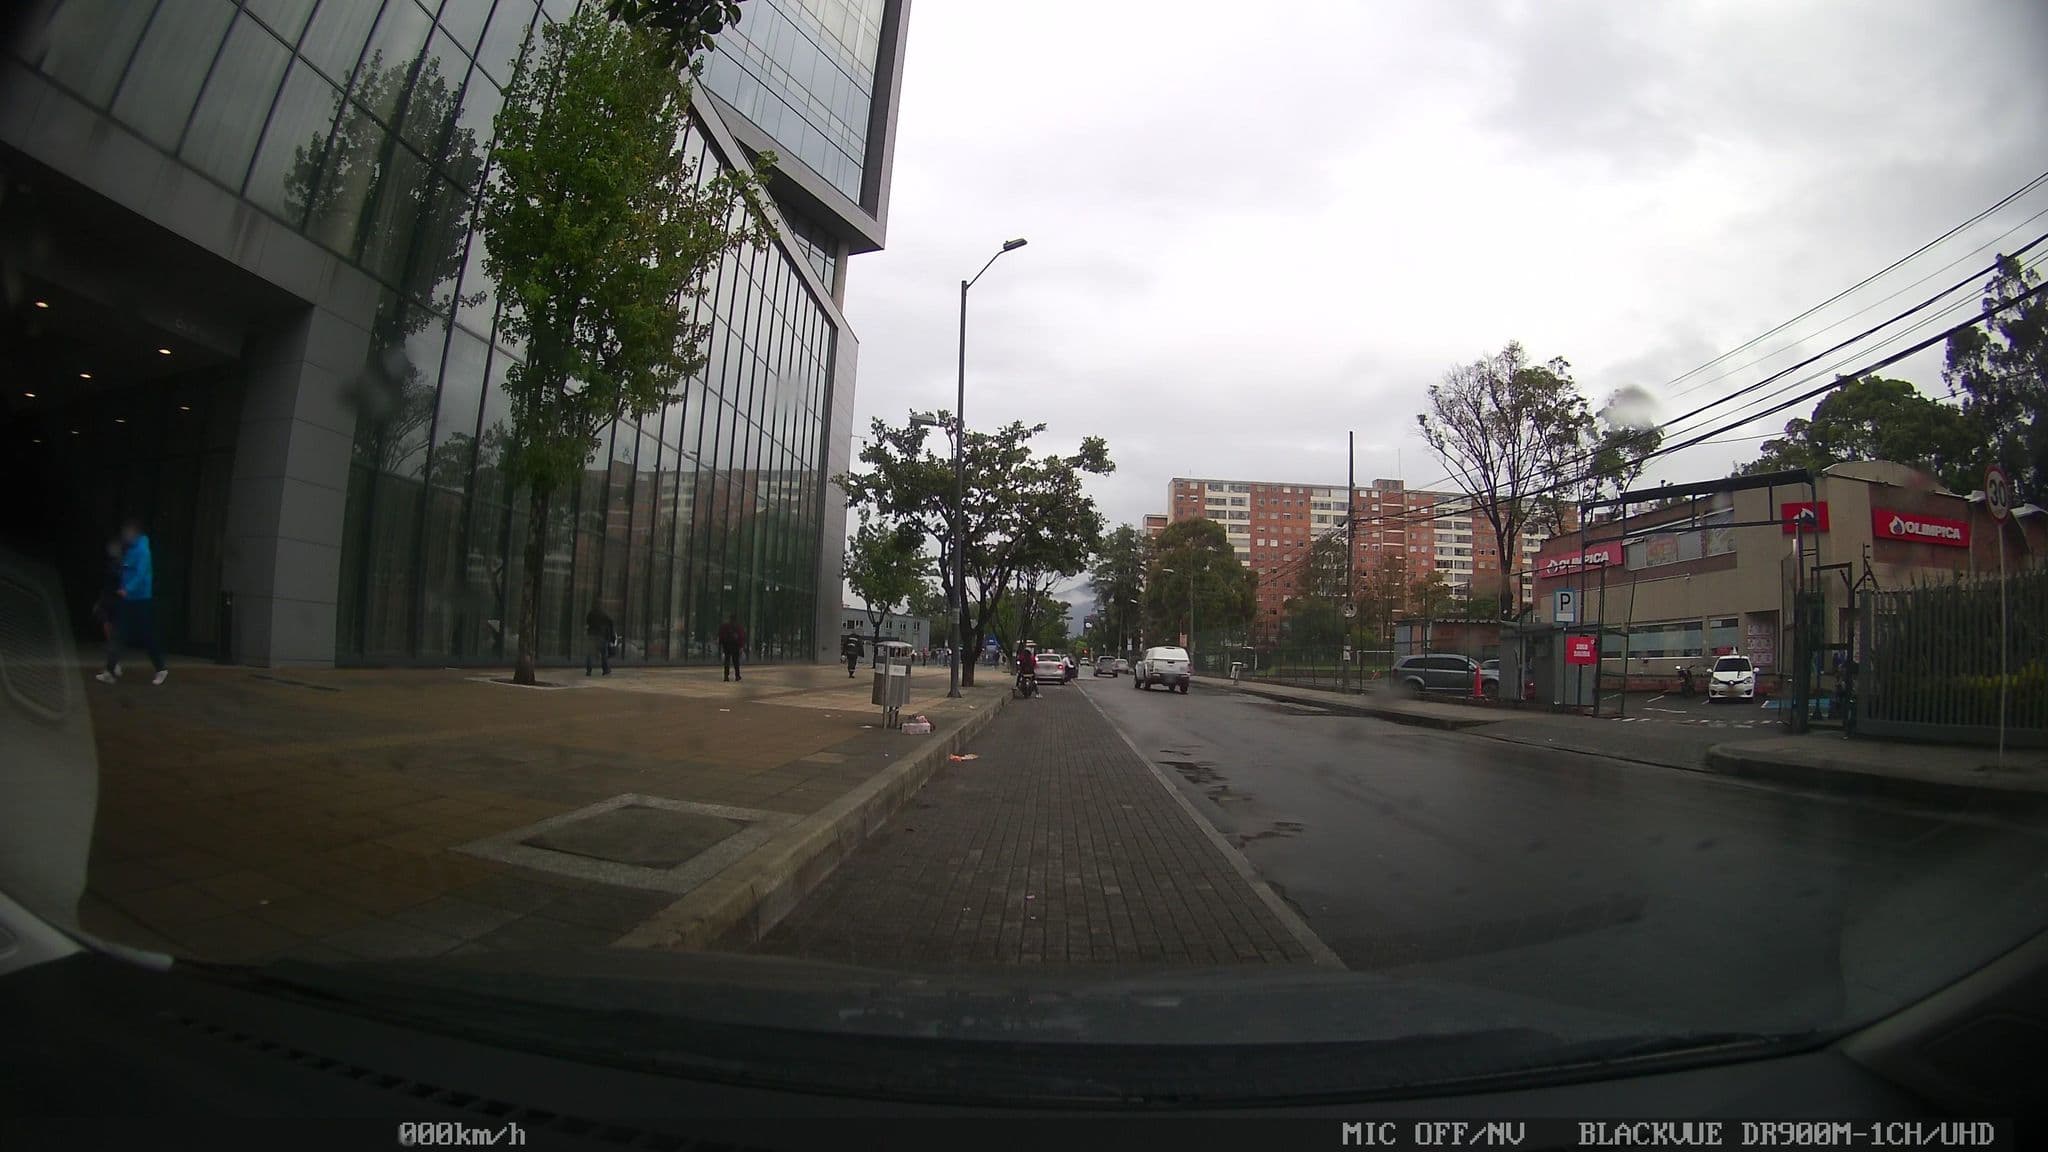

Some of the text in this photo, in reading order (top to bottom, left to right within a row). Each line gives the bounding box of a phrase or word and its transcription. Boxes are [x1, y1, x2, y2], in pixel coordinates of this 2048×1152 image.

[1989, 479, 2007, 506] 30
[1905, 522, 1961, 540] OLIMPICA
[1560, 593, 1571, 611] P
